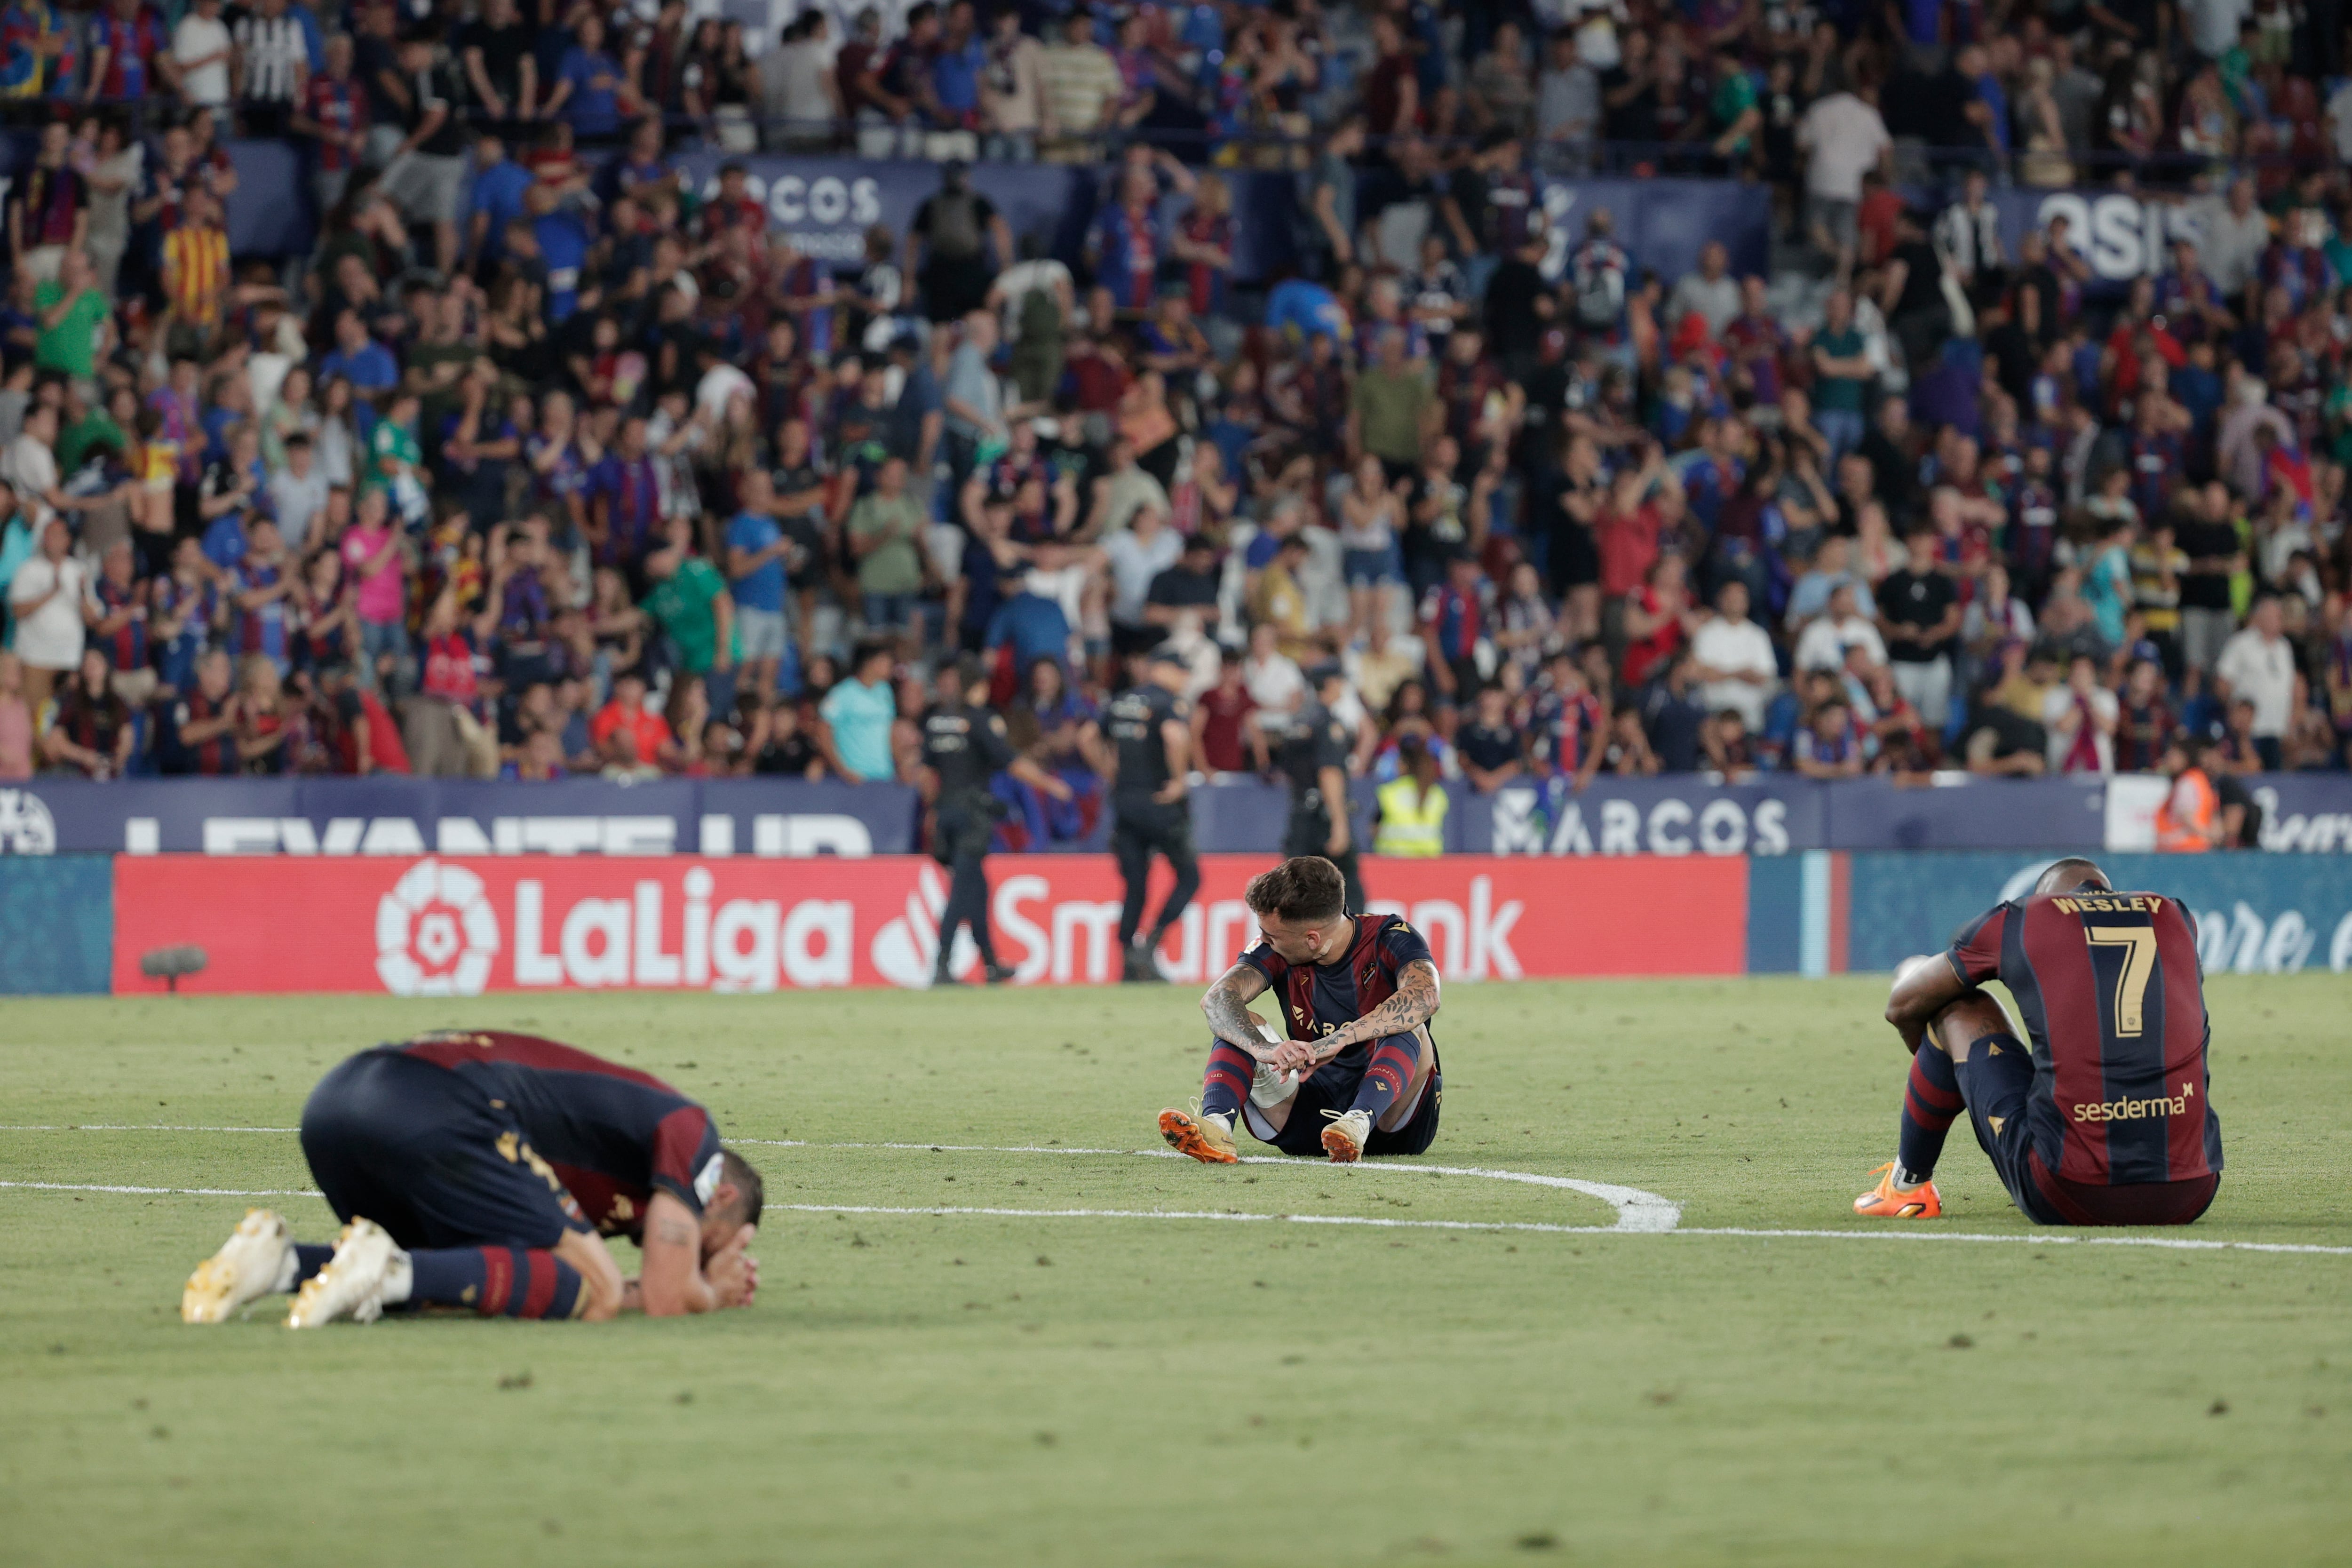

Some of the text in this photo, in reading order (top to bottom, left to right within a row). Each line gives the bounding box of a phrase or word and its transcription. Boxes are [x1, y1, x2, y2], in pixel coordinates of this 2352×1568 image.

[1493, 788, 1789, 858] MARCOS
[514, 866, 854, 994] LaLiga
[2051, 897, 2162, 915] WESLEY
[2084, 926, 2157, 1038] 7
[2074, 1095, 2186, 1122] sesderma
